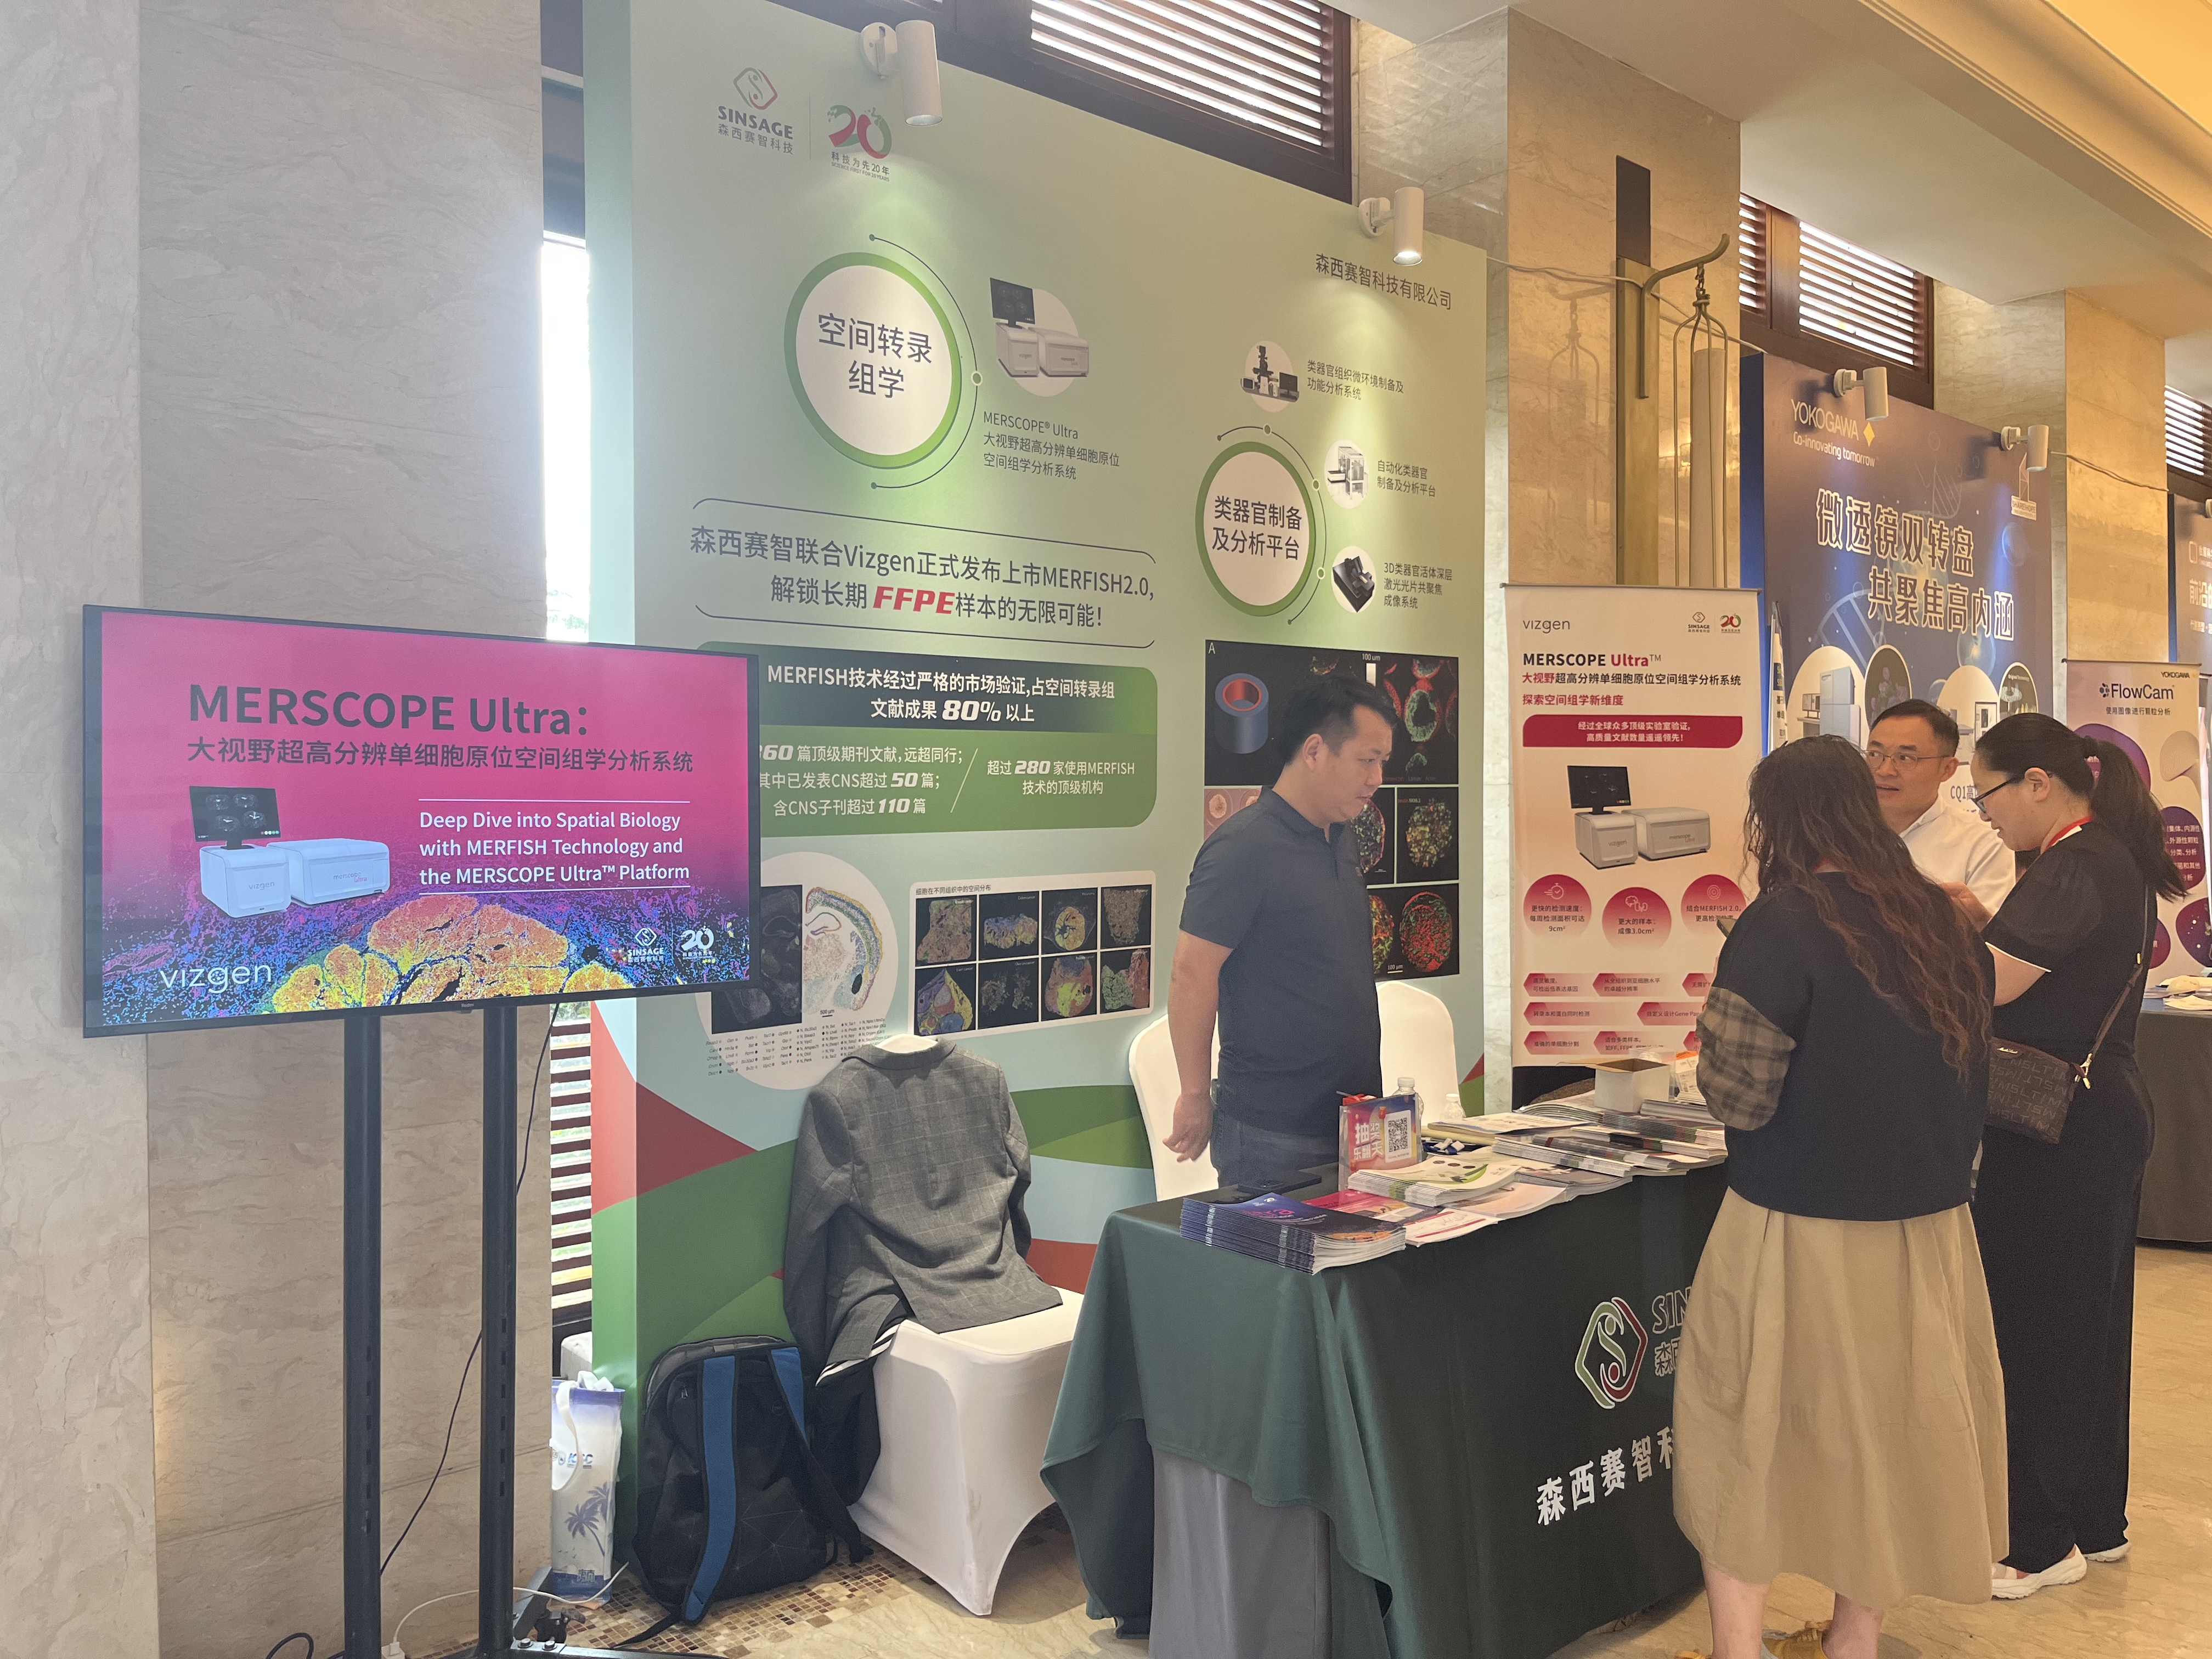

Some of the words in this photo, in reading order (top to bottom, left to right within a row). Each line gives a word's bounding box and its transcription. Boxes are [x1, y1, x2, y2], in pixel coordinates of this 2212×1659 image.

[718, 106, 793, 139] SINSAGE
[718, 123, 793, 155] 森西赛智科技
[831, 151, 889, 175] 科技为先20年
[831, 162, 849, 171] SCIENCE
[1316, 253, 1452, 311] 森西赛智科技有限公司
[817, 312, 933, 364] 空间转录
[848, 360, 905, 399] 组学
[1307, 359, 1404, 393] 类器官组织微环境制备及
[1307, 377, 1362, 400] 功能分析系统
[1791, 399, 1859, 441] YOKOGAWA
[1053, 424, 1079, 439] Ultra
[984, 431, 1120, 467] 大视野超高分辨单细胞原位
[1793, 431, 1842, 460] Co-innovating
[1842, 447, 1875, 467] tomorrow
[984, 453, 1077, 480] 空间组学分析系统
[1377, 460, 1428, 480] 自动化类器官
[1377, 476, 1436, 498] 制备及分析平台
[1214, 495, 1302, 531] 类器官制备
[1816, 488, 1974, 578] 微透镜双转盘
[1212, 527, 1300, 561] 及分析平台
[1384, 562, 1453, 582] 3D类器官活体深层
[770, 574, 868, 610] 解锁长期
[1384, 578, 1443, 596] 激光光片共聚焦
[1384, 594, 1418, 610] 成像系统
[1867, 565, 2015, 641] 共聚焦高内涵
[1522, 619, 1570, 634] vizgen
[1208, 642, 1216, 654] A
[1523, 653, 1606, 667] MERSCOPE
[768, 664, 1115, 699] MERFISH技术经过严格的市场验证,占空间转录组
[1522, 672, 1741, 686] 大视野超高分辨单细胞原位空间组学分析系统
[1522, 693, 1624, 706] 探索空间组学新维度
[2112, 683, 2174, 700] FlowCam
[189, 683, 455, 731] MERSCOPE
[871, 698, 938, 720] 文献成果
[941, 699, 1002, 723] 80%
[1006, 704, 1035, 723] 以上
[188, 736, 693, 774] 大视野超高分辨单细胞原位空间组学分析系统
[760, 745, 794, 761] 60
[987, 760, 1012, 777] 超过
[1014, 760, 1051, 775] 280
[1053, 760, 1136, 777] 家使用MERFISH
[890, 772, 918, 788] 50
[1022, 778, 1104, 795] 技术的顶级机构
[1950, 785, 1978, 803] CQ1高
[773, 799, 876, 817] 含CNS子刊超过
[878, 798, 910, 814] 110
[913, 798, 926, 815] 篇
[420, 812, 468, 832] Deep
[473, 812, 512, 828] Dive
[517, 812, 552, 828] into
[556, 812, 615, 831] Spatial
[620, 812, 681, 832] Biology
[419, 840, 461, 856] with
[467, 840, 547, 856] MERFISH
[552, 838, 649, 858] Technology
[653, 838, 682, 854] and
[333, 871, 362, 881] merscope
[419, 867, 451, 885] the
[456, 866, 556, 884] MERSCOPE
[620, 864, 690, 880] Platform
[249, 881, 275, 890] vizgen
[916, 884, 991, 895] 细胞在不同组织中的空间分布
[627, 947, 665, 957] SINSAGE
[159, 962, 272, 994] vizgen
[1355, 1121, 1380, 1144] 抽奖
[1353, 1140, 1384, 1160] 乐翻天
